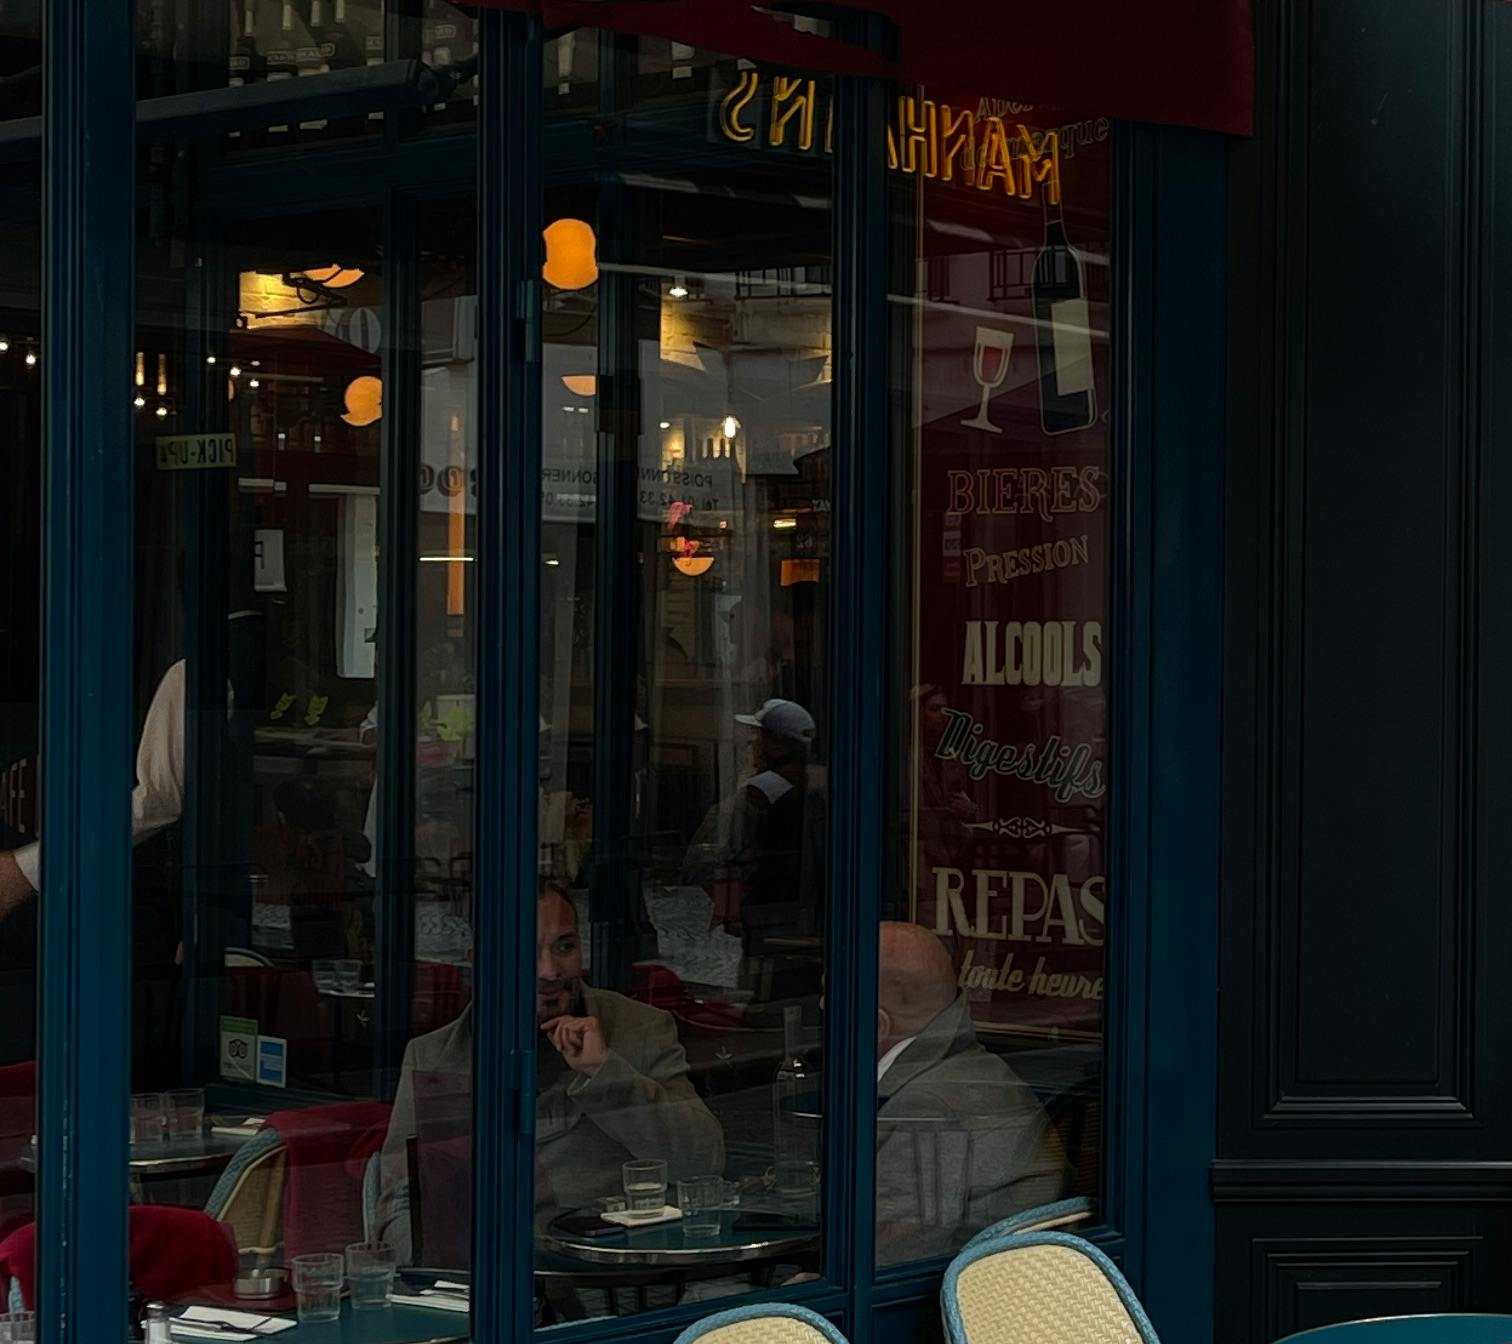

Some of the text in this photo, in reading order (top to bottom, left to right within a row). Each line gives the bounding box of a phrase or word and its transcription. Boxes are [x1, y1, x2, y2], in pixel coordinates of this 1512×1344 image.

[946, 466, 1102, 523] BIERES
[961, 620, 1103, 687] ALCOOLS
[935, 708, 1105, 803] Digestifs
[930, 866, 1104, 945] REPAS
